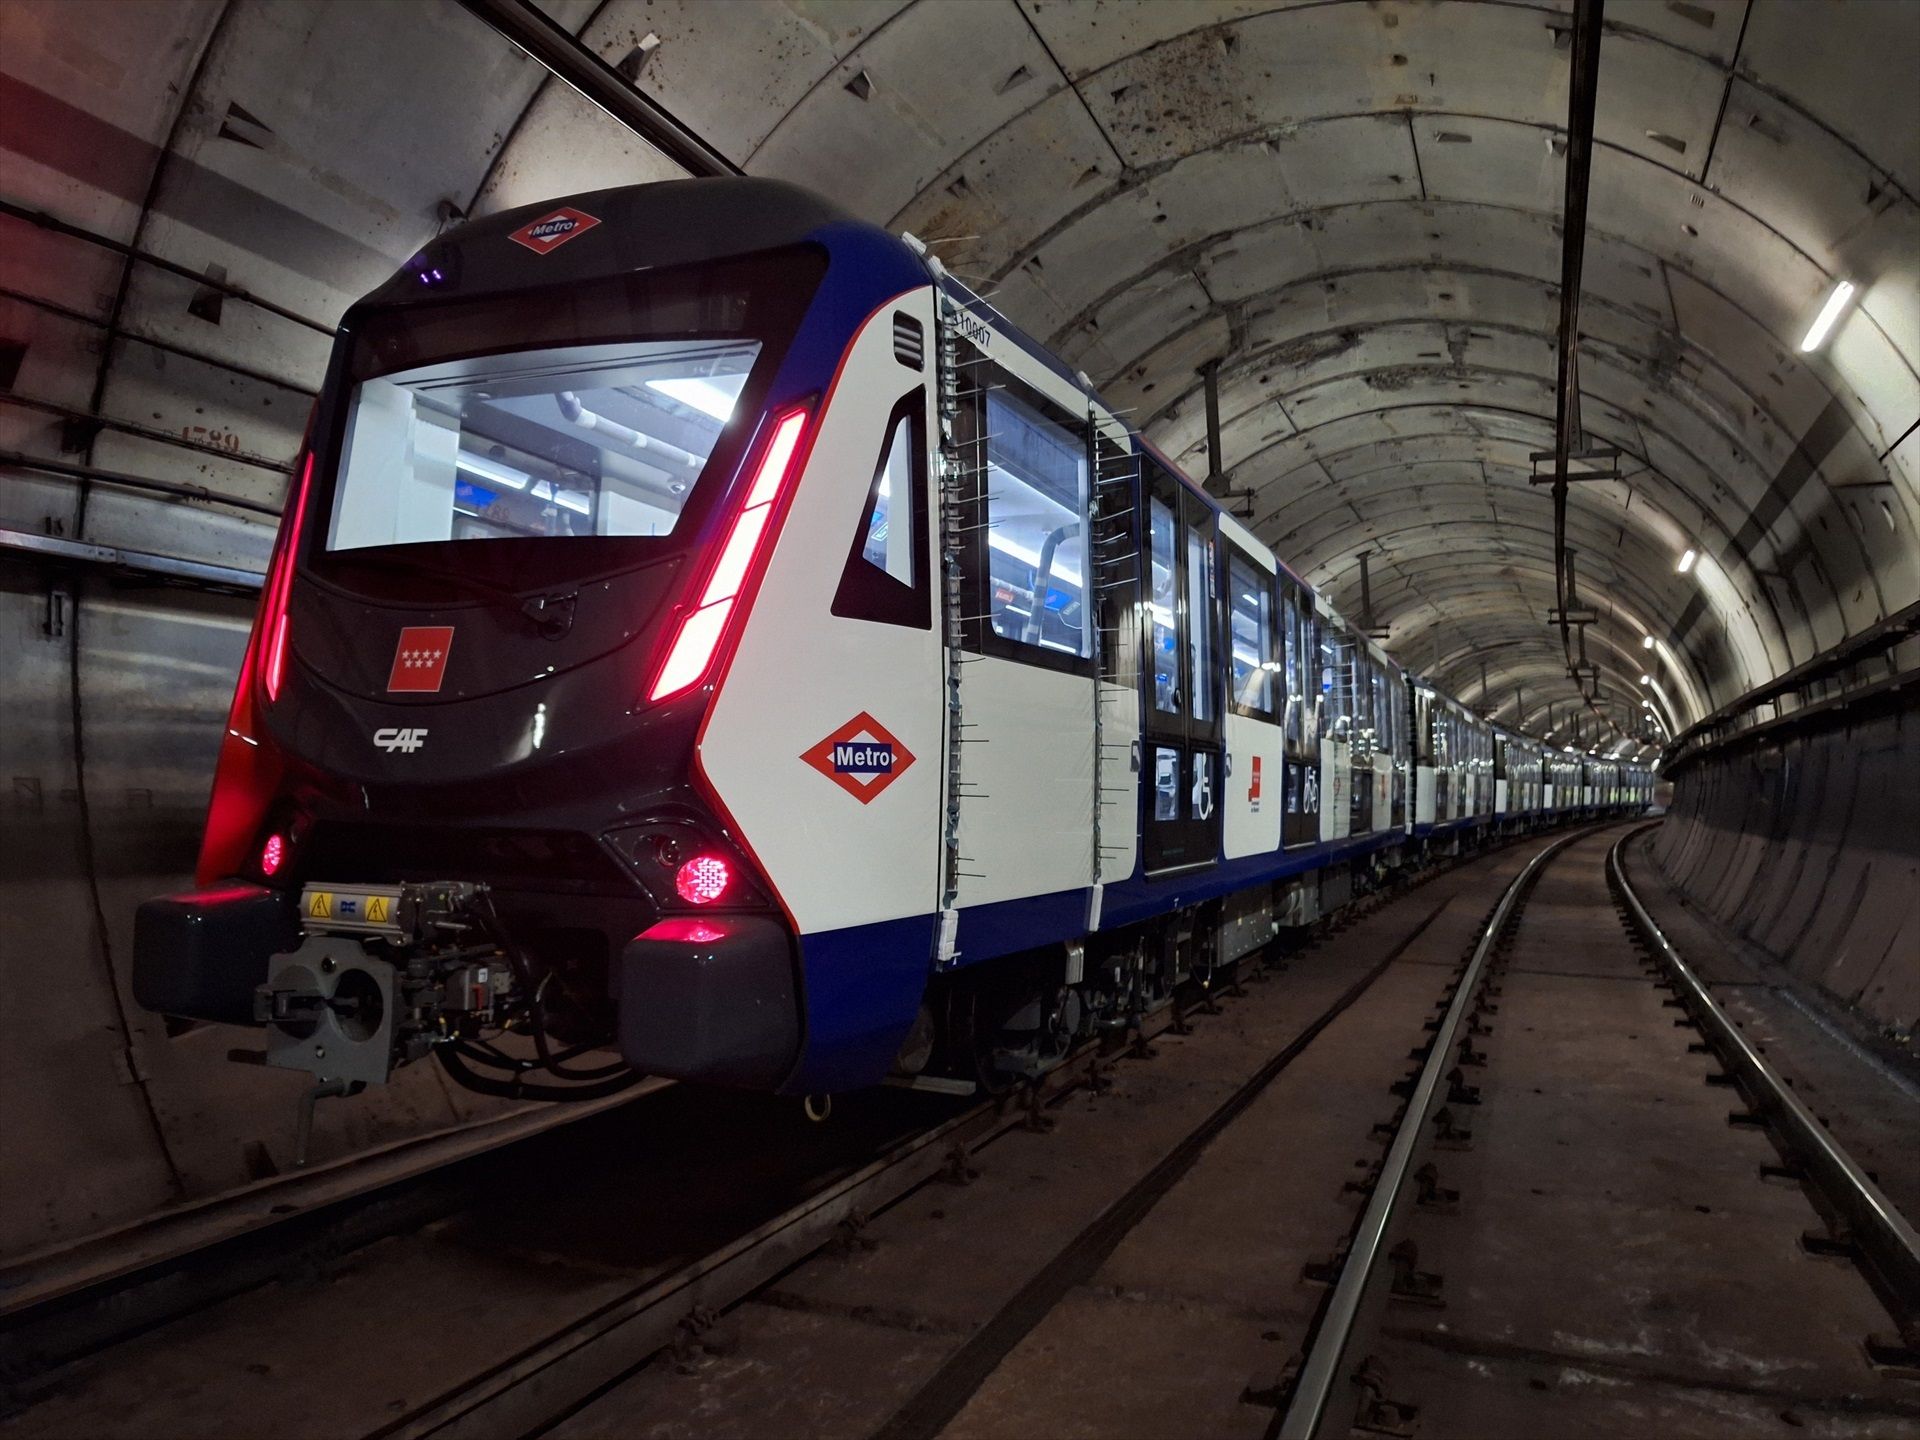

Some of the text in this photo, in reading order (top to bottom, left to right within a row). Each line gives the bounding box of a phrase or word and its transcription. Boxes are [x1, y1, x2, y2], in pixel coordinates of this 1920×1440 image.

[533, 221, 573, 236] Metro
[373, 728, 429, 753] CAF
[836, 746, 890, 766] Metro
